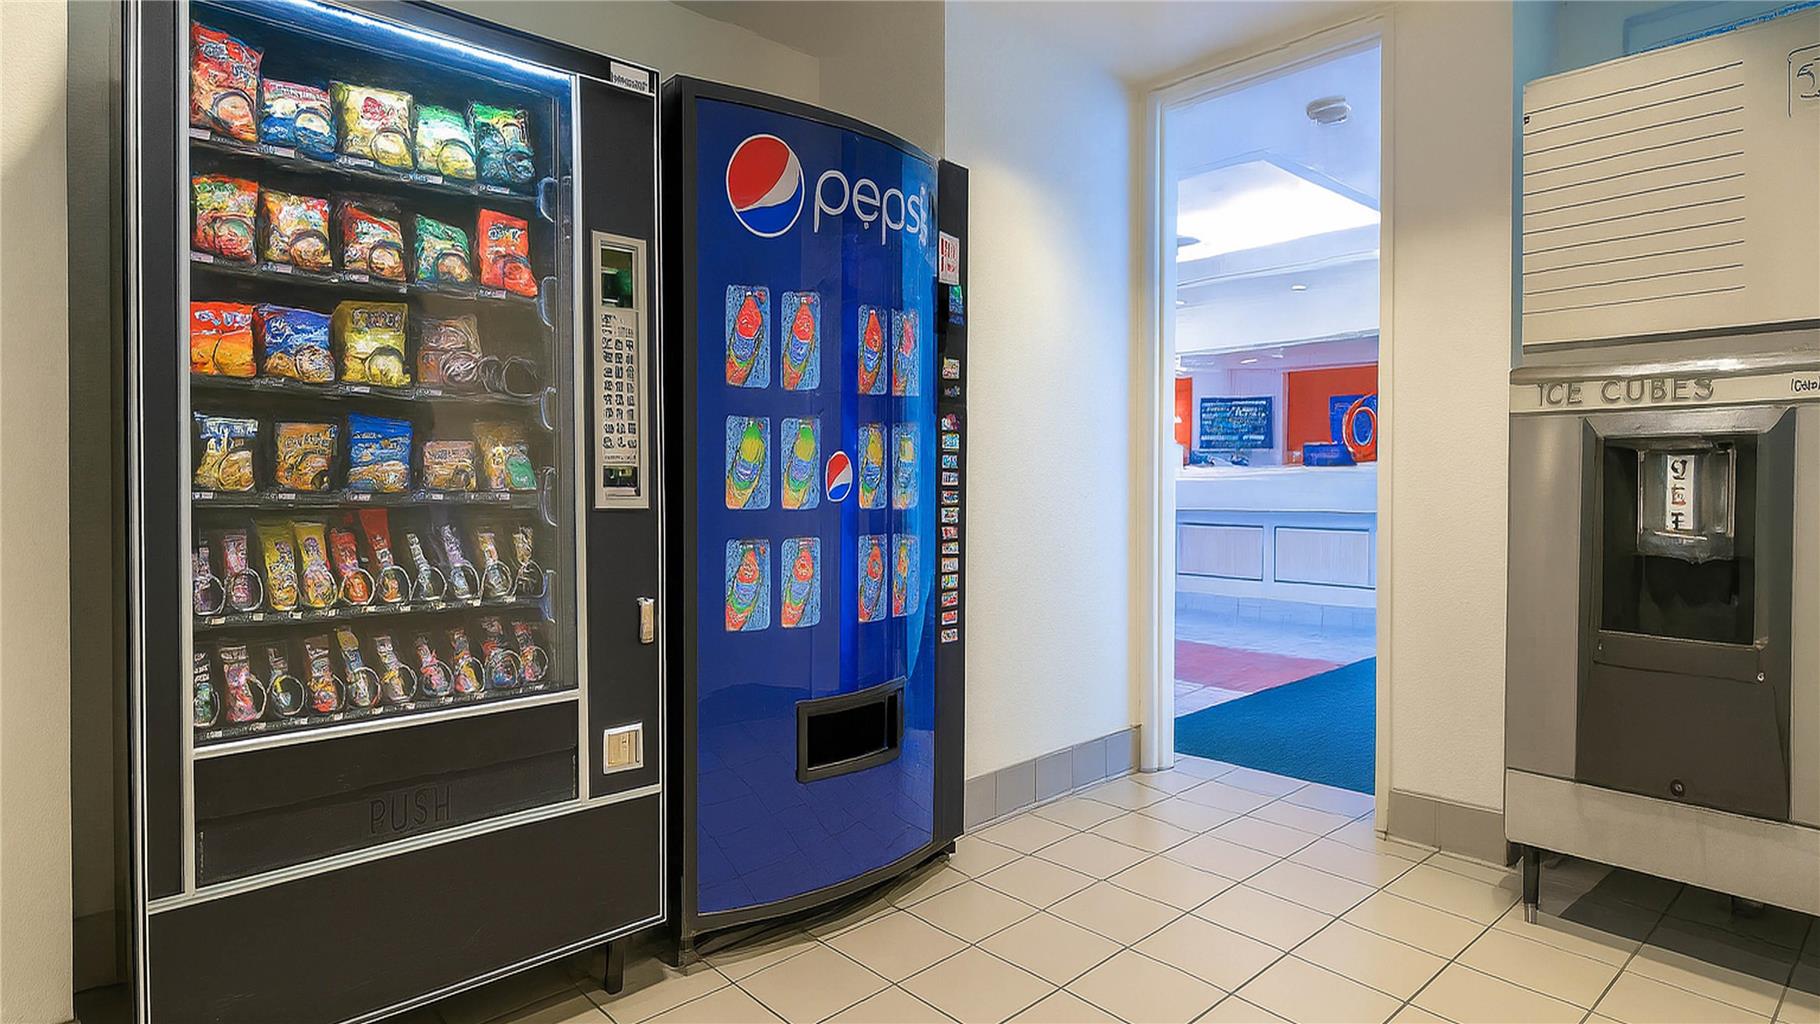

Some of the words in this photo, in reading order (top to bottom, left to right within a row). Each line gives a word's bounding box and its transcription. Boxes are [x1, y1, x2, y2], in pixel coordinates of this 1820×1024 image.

[1538, 382, 1582, 406] ICE
[1601, 376, 1714, 404] CUBES
[369, 784, 450, 834] PUSH
